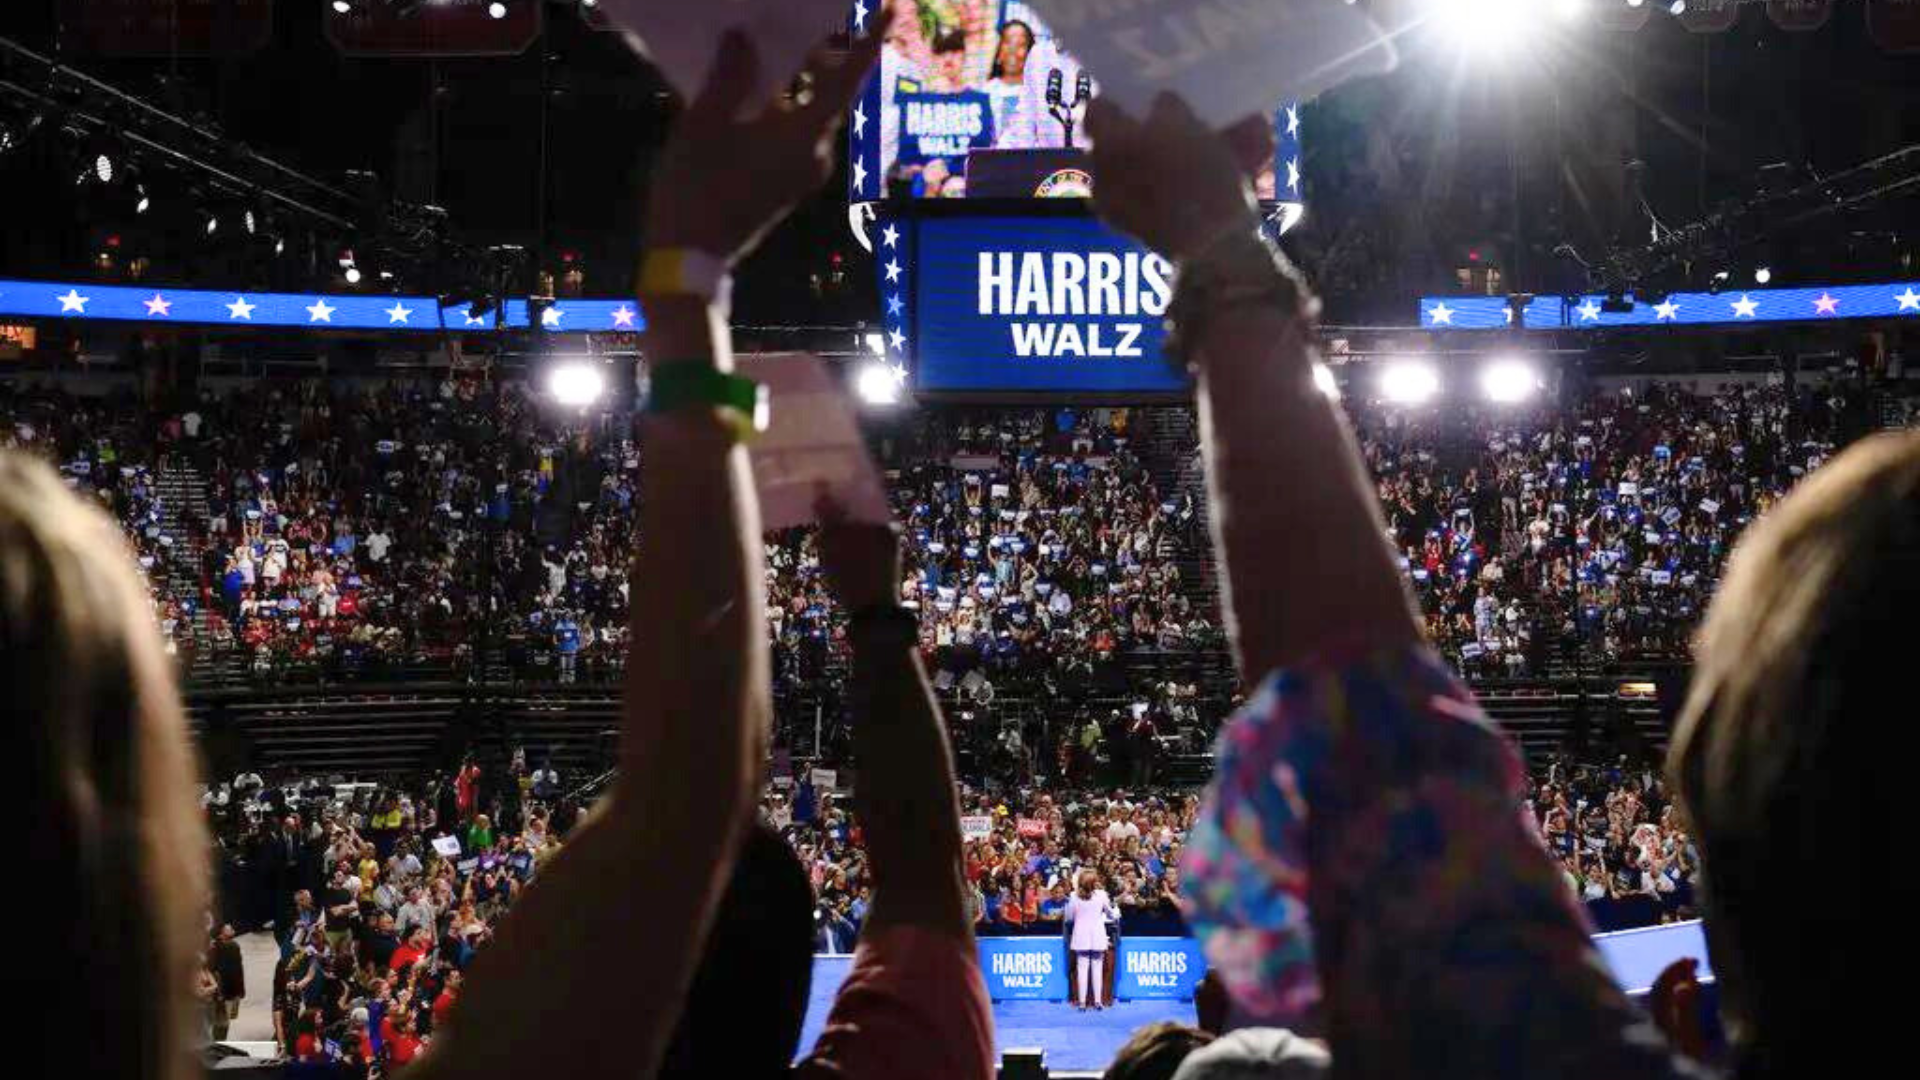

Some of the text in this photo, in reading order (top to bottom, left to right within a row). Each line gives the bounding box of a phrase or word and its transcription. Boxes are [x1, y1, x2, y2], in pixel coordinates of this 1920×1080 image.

[906, 101, 982, 136] HARRIS
[918, 136, 970, 155] WALZ
[978, 251, 1173, 315] HARRIS
[1011, 322, 1143, 356] WALZ
[993, 952, 1052, 974] HARRIS
[1127, 951, 1187, 973] HARRIS
[1003, 975, 1043, 987] WALZ
[1138, 974, 1178, 986] WALZ
